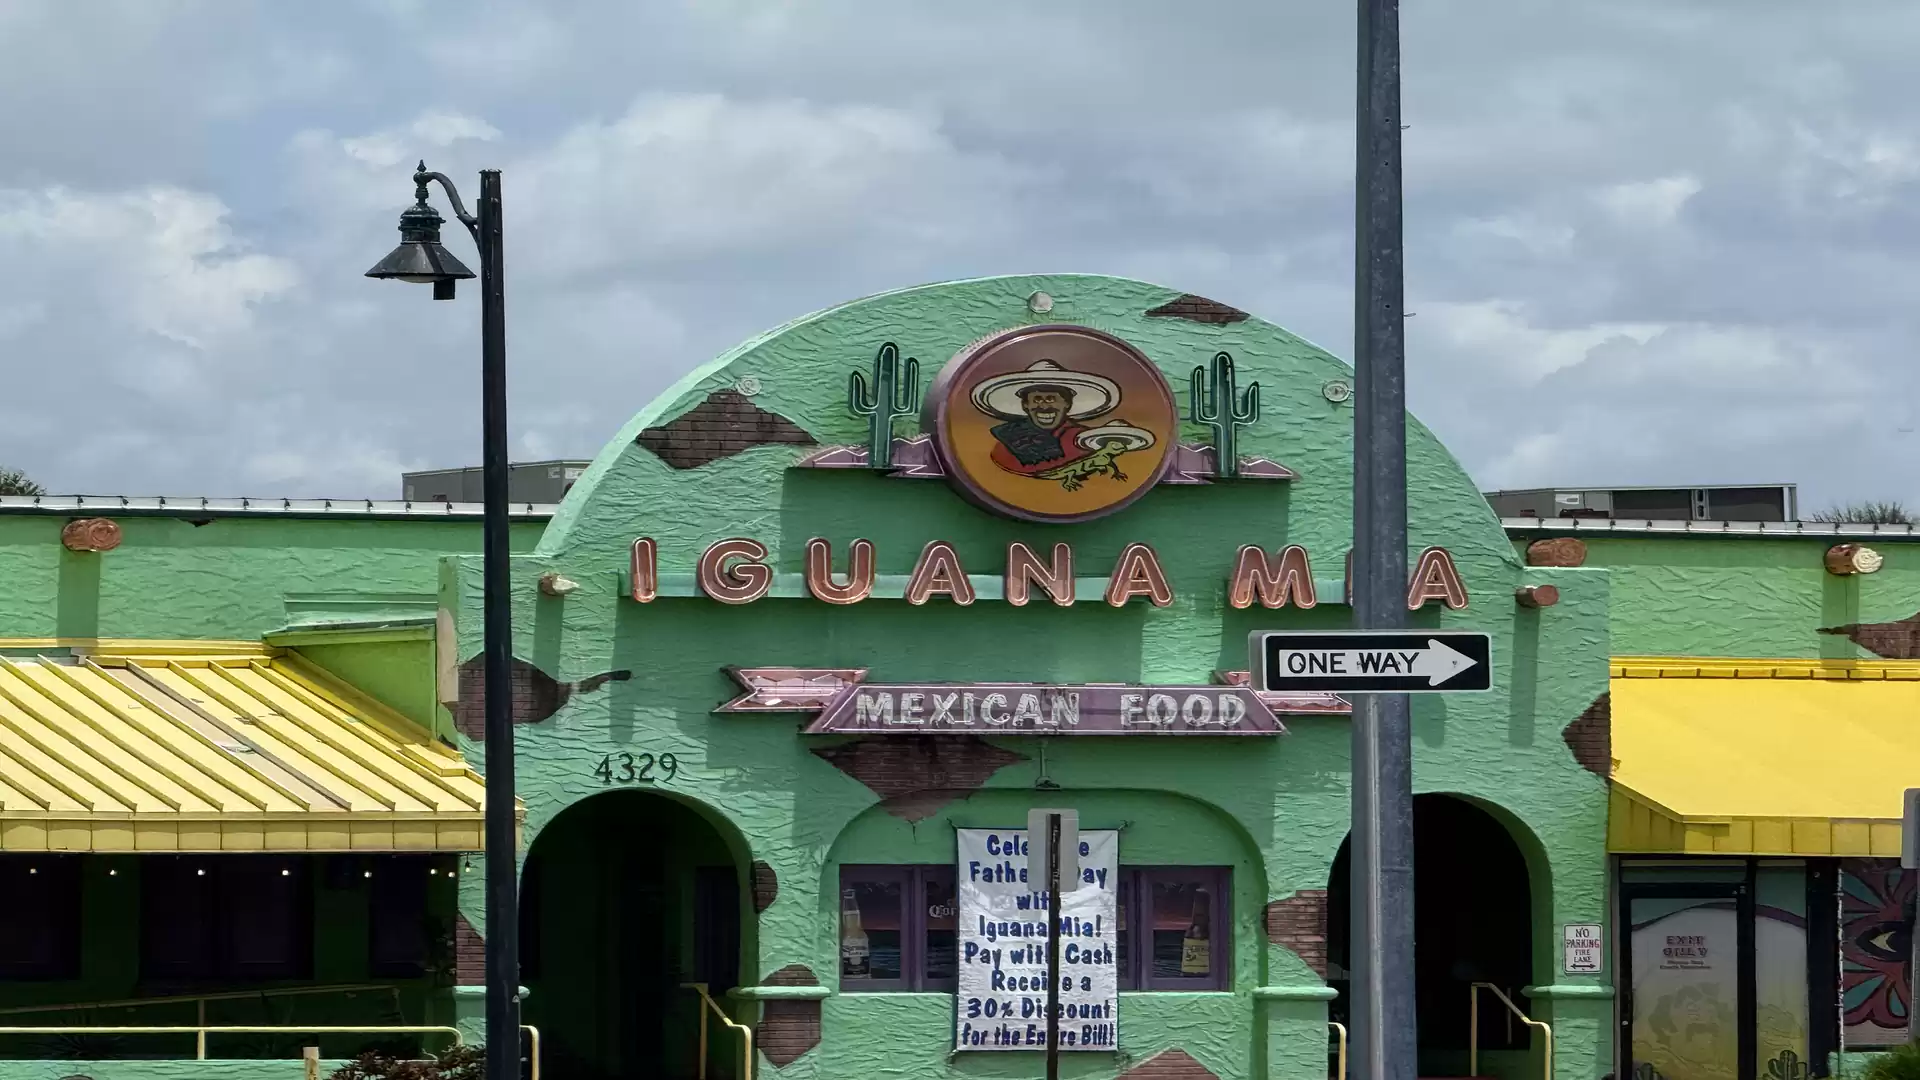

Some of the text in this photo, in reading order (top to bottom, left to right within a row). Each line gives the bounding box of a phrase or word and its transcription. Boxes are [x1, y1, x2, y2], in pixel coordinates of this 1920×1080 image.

[631, 537, 1468, 610] IGUANA MA
[1288, 652, 1420, 674] ONE WAY
[856, 692, 1246, 727] MEXICAN FOOD
[594, 752, 677, 785] 4329
[987, 834, 1090, 857] Celee
[1078, 866, 1107, 889] ay
[1016, 892, 1050, 910] wit
[979, 914, 1102, 942] Iguana Mia!
[1575, 928, 1590, 938] NO
[1566, 939, 1600, 948] PARKING
[965, 942, 1001, 970] Pay
[1065, 943, 1113, 964] Cash
[991, 970, 1091, 991] Receie a
[967, 998, 1013, 1018] 30%
[962, 1022, 988, 1045] for
[994, 1023, 1020, 1045] the
[1026, 1024, 1076, 1045] Enre
